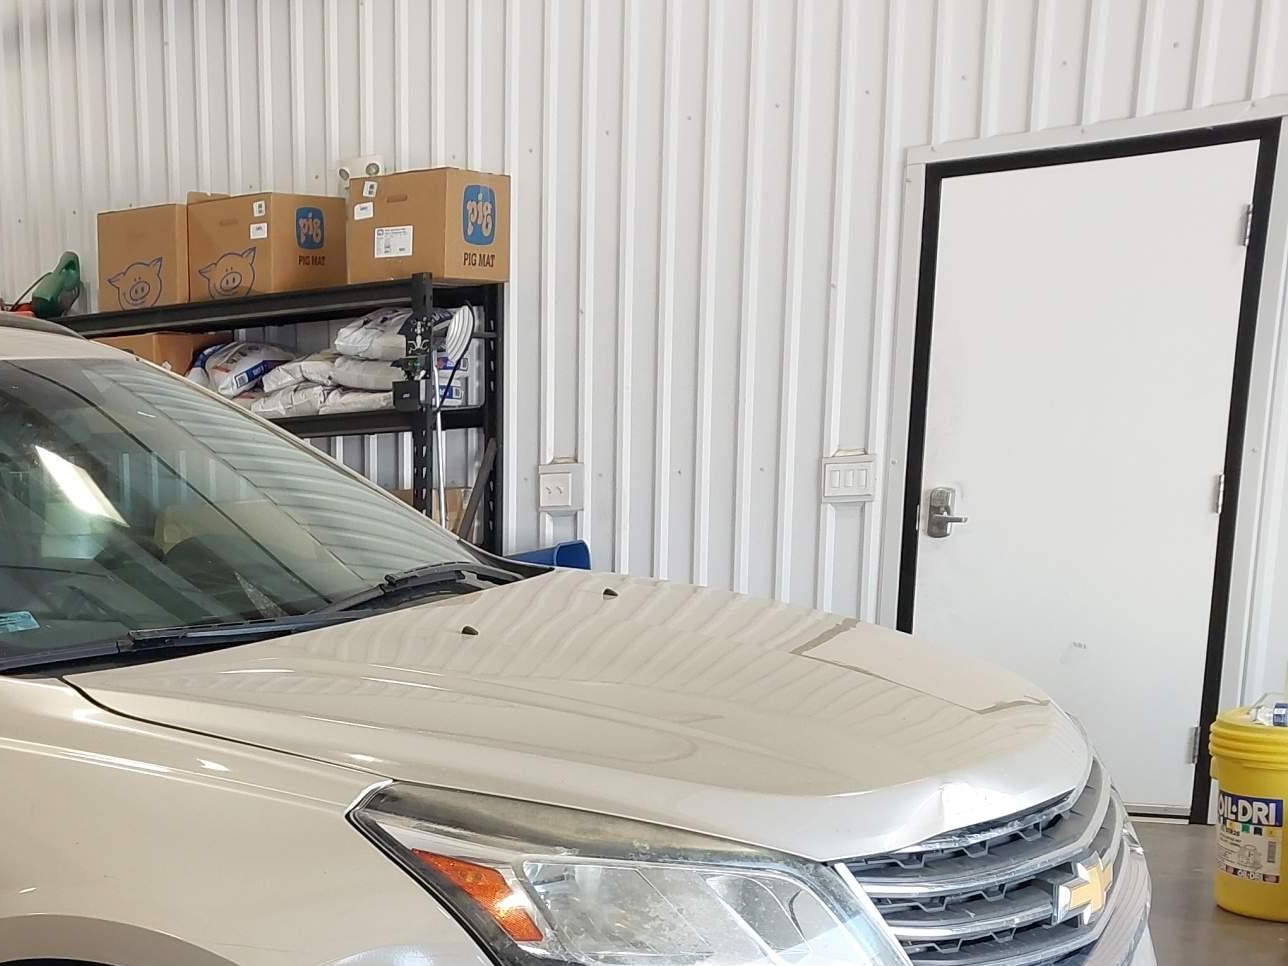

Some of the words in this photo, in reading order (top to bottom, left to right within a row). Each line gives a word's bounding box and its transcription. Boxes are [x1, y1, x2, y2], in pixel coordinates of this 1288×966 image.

[467, 192, 493, 237] pig
[463, 252, 477, 266] PIG
[478, 253, 496, 268] MAT
